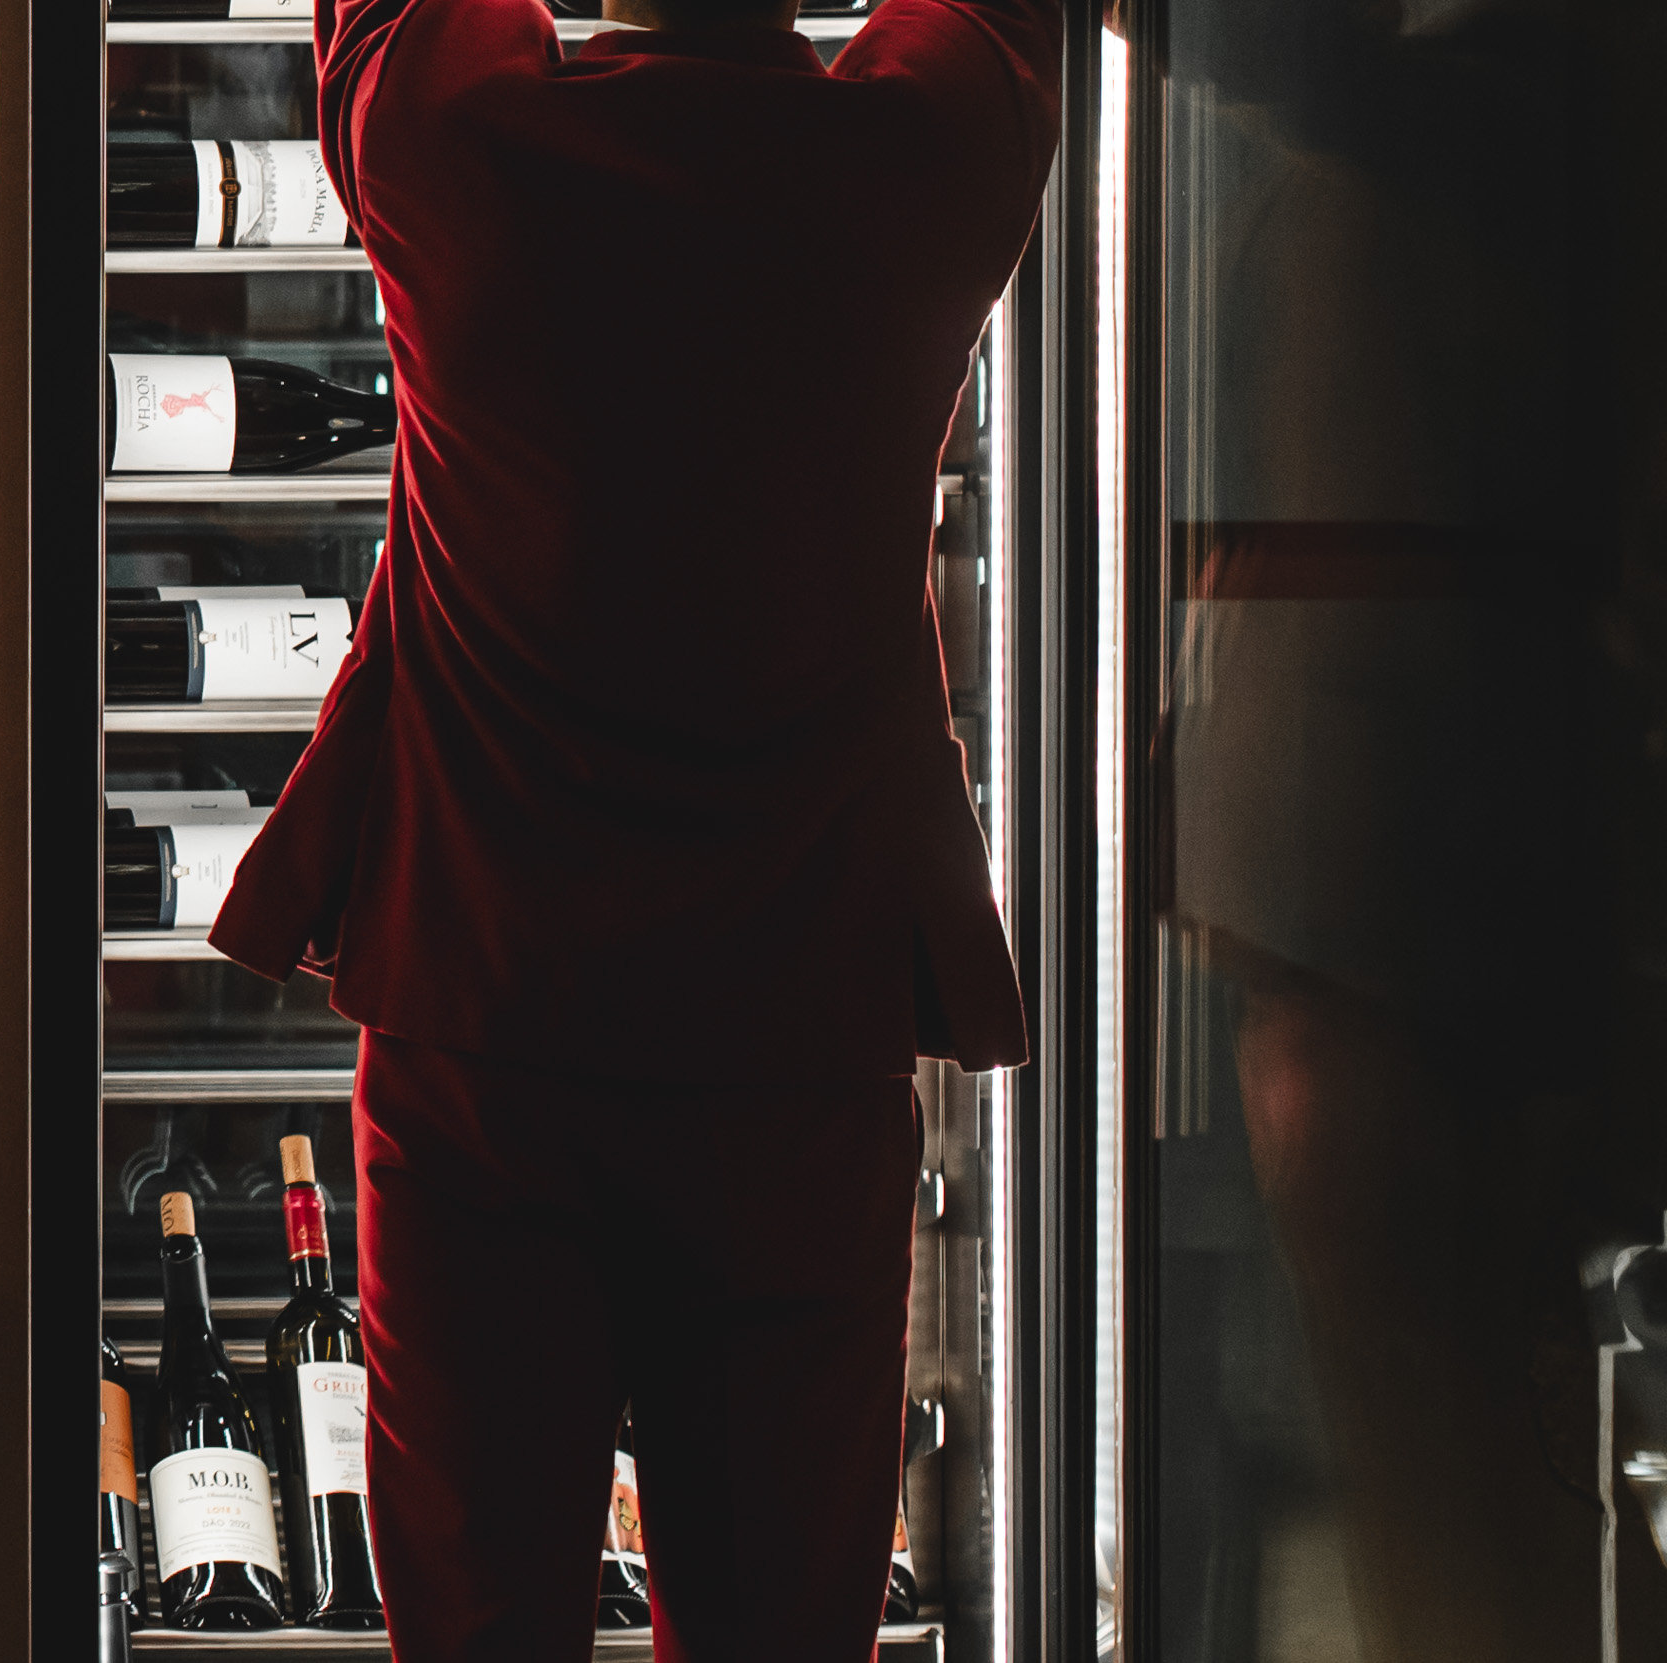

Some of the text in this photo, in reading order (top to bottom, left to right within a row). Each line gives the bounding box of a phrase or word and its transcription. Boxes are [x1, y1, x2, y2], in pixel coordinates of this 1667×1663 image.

[306, 149, 326, 234] DONA MARIA
[135, 375, 150, 432] ROCHA
[288, 611, 319, 668] LV
[187, 1469, 254, 1493] M.O.B.
[202, 1517, 252, 1530] DÃO 2022
